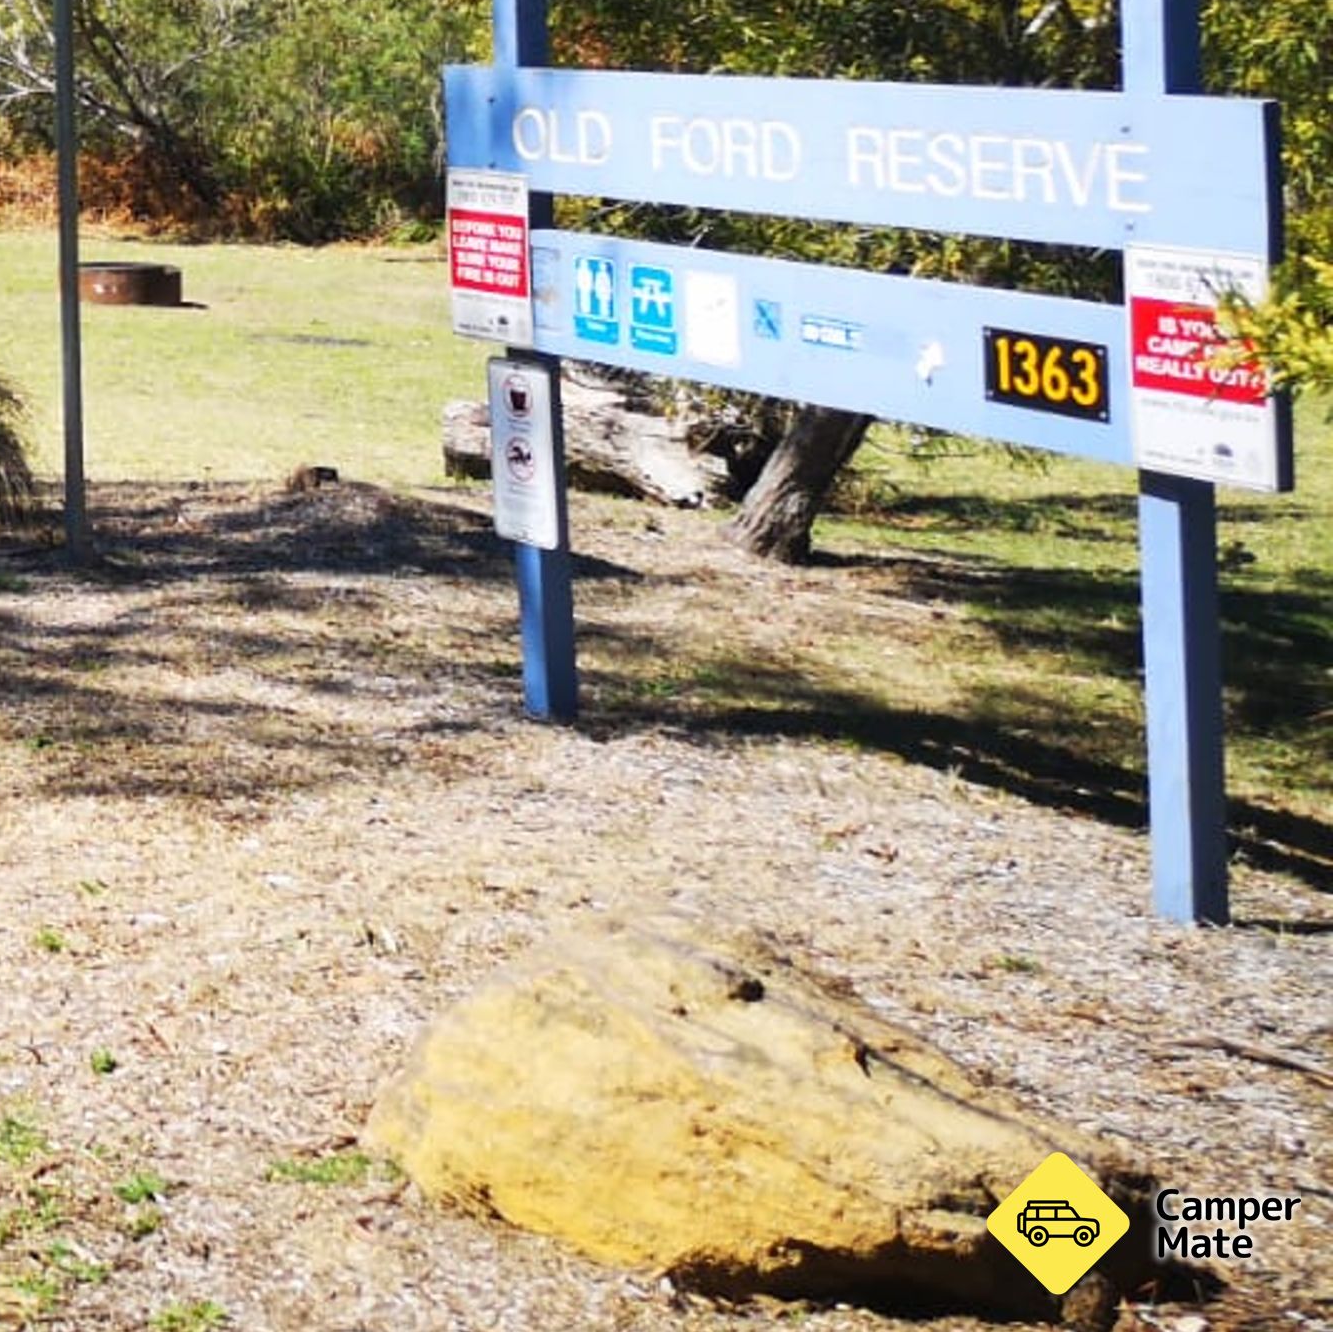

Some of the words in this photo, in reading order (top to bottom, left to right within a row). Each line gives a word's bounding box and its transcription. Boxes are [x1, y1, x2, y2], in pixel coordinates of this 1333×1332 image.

[512, 106, 614, 166] OLD
[649, 115, 802, 182] FORD
[845, 125, 1154, 213] RESERVE
[995, 336, 1100, 406] 1363
[1135, 355, 1207, 381] REALLY
